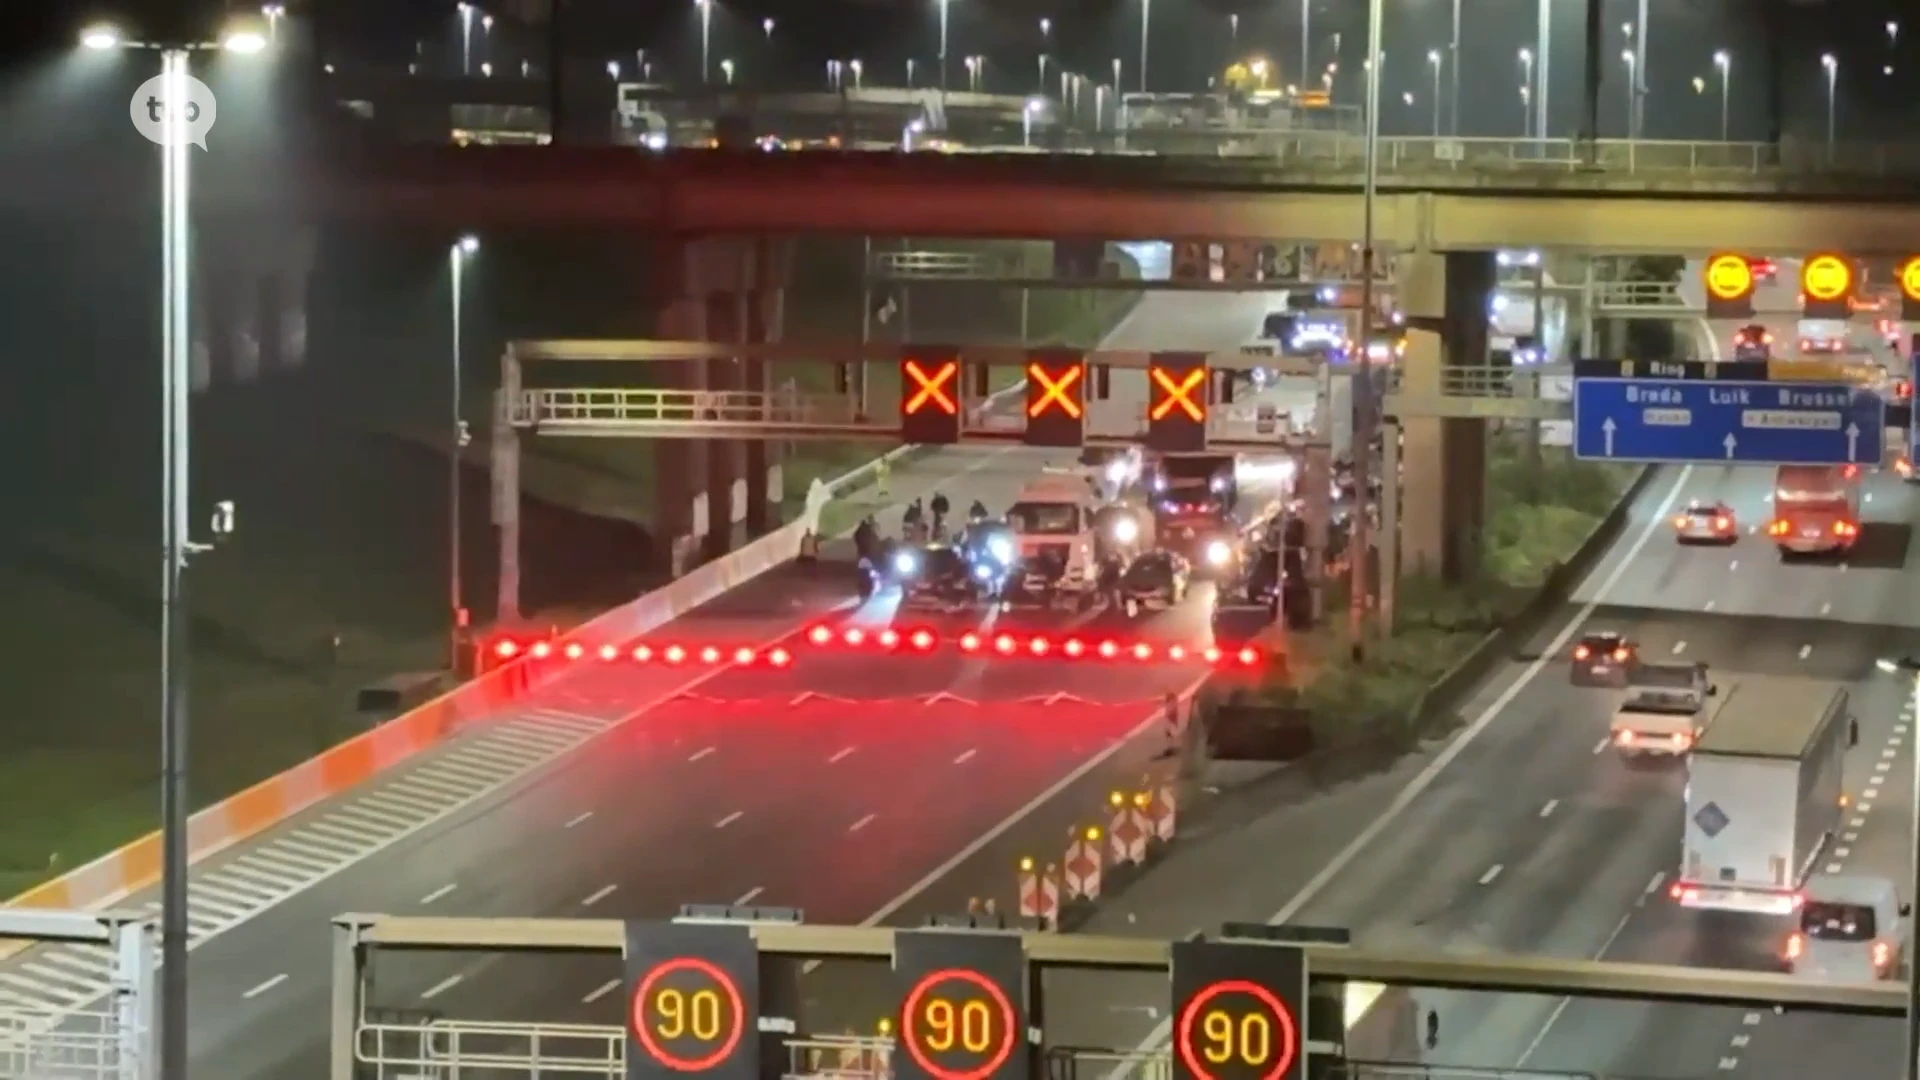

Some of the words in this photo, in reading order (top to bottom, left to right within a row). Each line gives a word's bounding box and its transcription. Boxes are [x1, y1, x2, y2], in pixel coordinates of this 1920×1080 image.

[1626, 385, 1683, 404] Breda
[1709, 387, 1750, 405] Luik
[1651, 361, 1685, 378] Ring
[657, 988, 719, 1040] 90
[925, 999, 990, 1052] 90
[1204, 1010, 1269, 1066] 90
